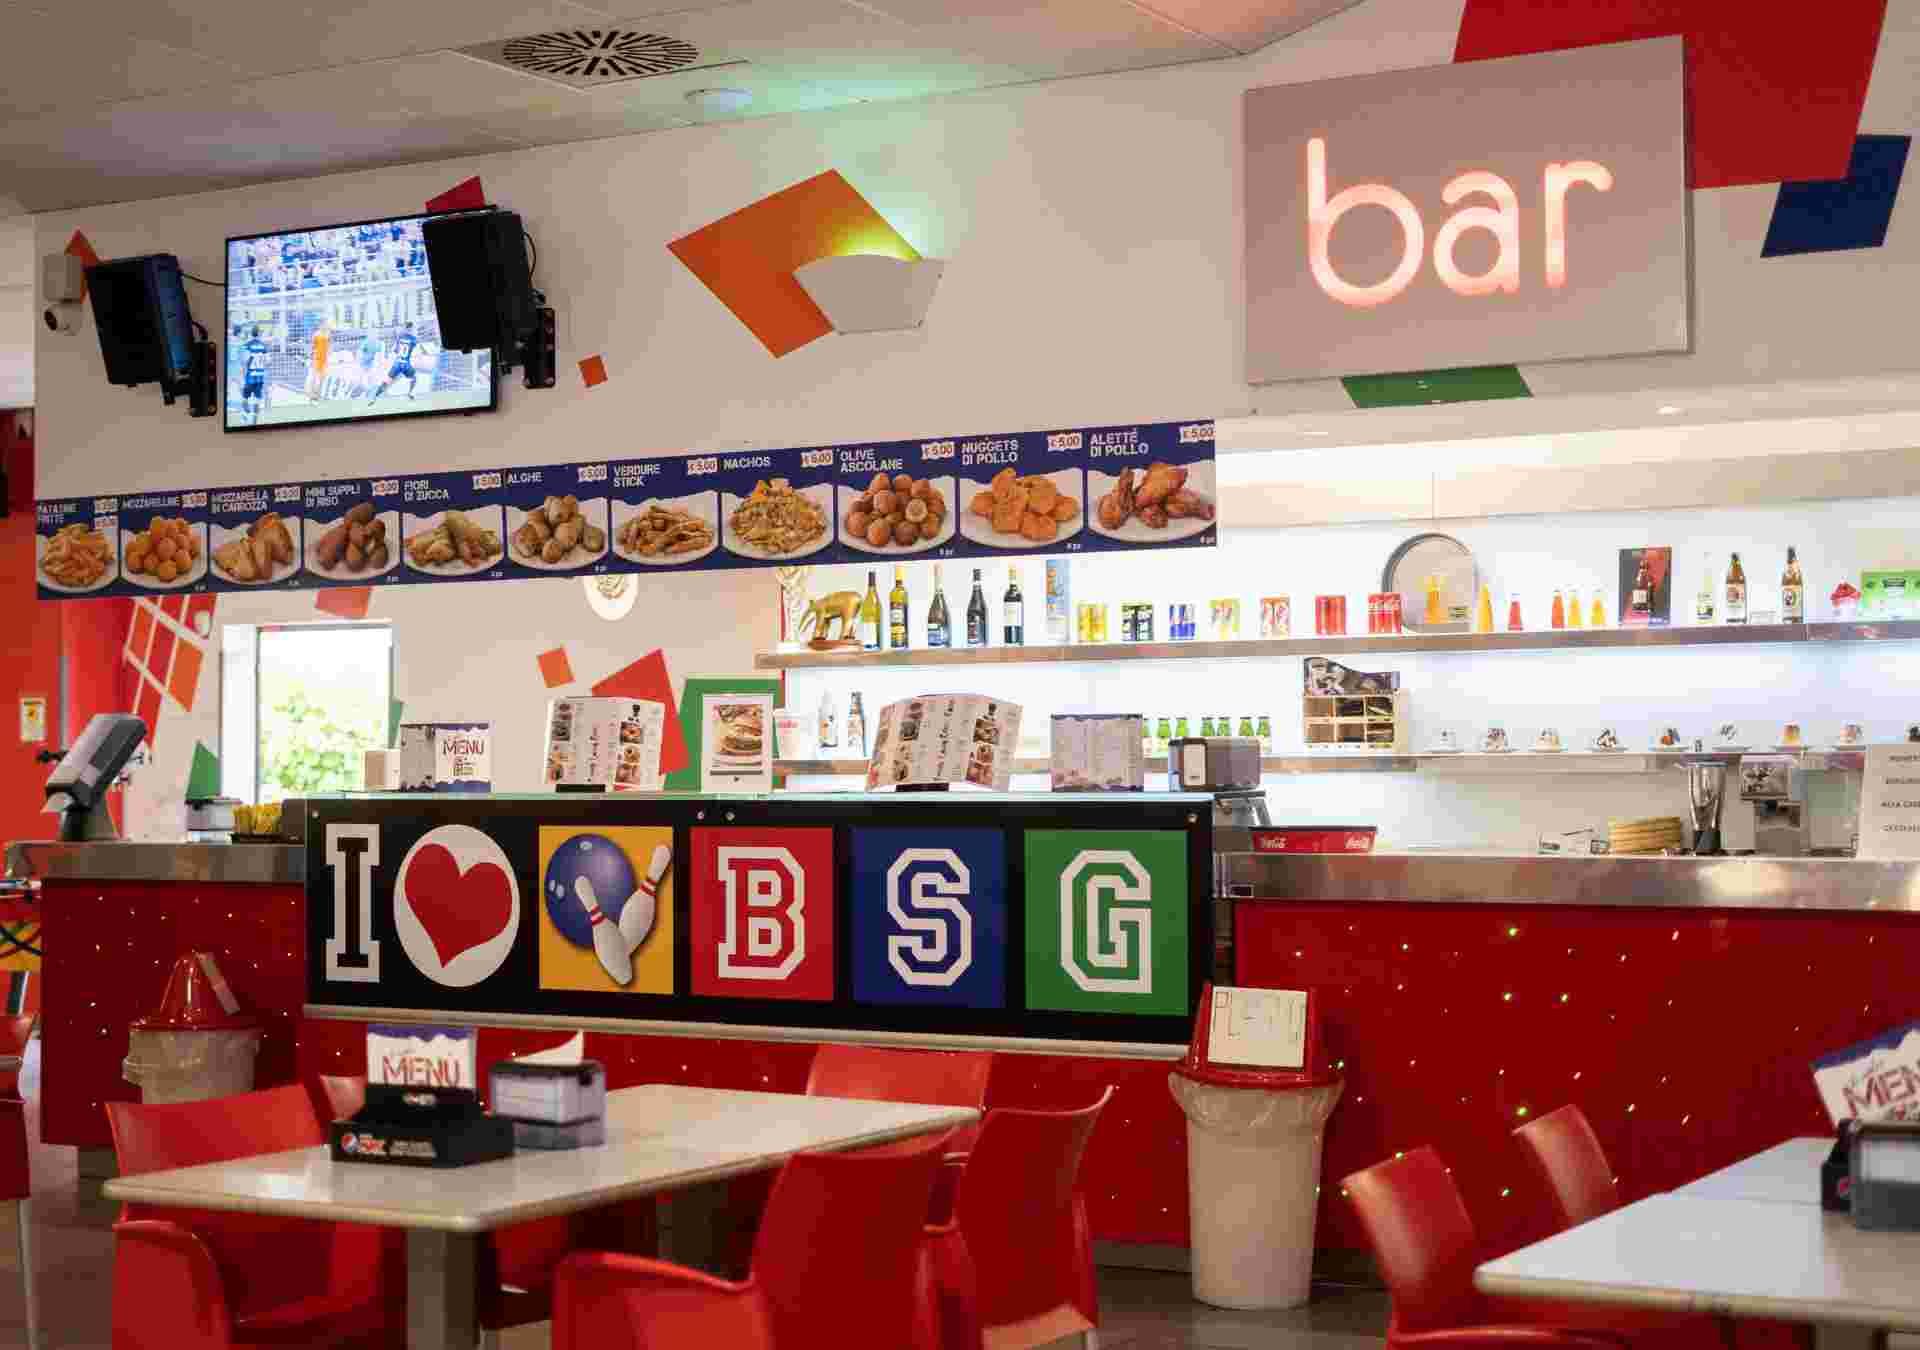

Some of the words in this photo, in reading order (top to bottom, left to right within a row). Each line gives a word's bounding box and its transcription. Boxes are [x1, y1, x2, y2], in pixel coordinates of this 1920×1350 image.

[1307, 137, 1614, 307] bar
[1090, 431, 1139, 445] ALETTE
[961, 439, 1019, 454] NUGGETS
[1090, 446, 1102, 457] DI
[1104, 442, 1150, 457] POLLO
[839, 448, 875, 461] OLIVE
[961, 454, 973, 465] DI
[976, 451, 1018, 465] POLLO
[613, 463, 661, 476] VERDURE
[723, 456, 771, 470] NACHOS
[840, 458, 903, 473] ASCOLANE
[403, 479, 429, 490] FIORI
[507, 471, 543, 484] ALGHE
[613, 476, 645, 488] STICK
[416, 489, 449, 501] ZUCCA
[443, 739, 484, 755] MENU
[325, 823, 381, 983] I
[717, 846, 806, 980] B
[887, 847, 973, 986] S
[1060, 849, 1153, 994] G
[382, 1055, 461, 1086] MENU
